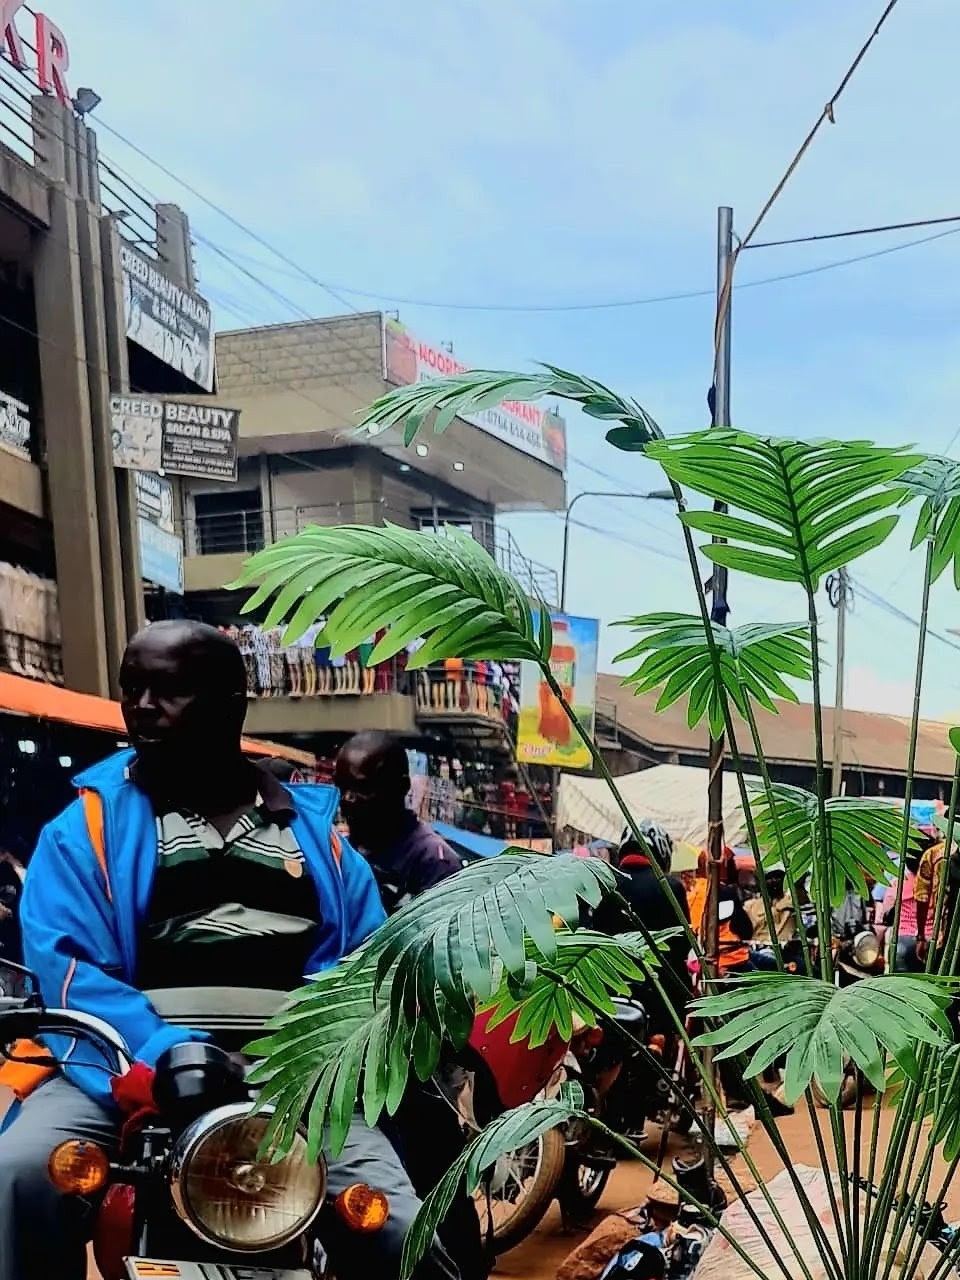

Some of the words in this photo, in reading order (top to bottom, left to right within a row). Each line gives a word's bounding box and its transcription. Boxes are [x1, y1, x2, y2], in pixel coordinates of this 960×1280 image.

[149, 267, 183, 309] BEAUTY
[111, 398, 163, 418] CREED
[165, 403, 234, 427] BEAUTY
[166, 422, 200, 438] SALON
[211, 427, 232, 442] SPA
